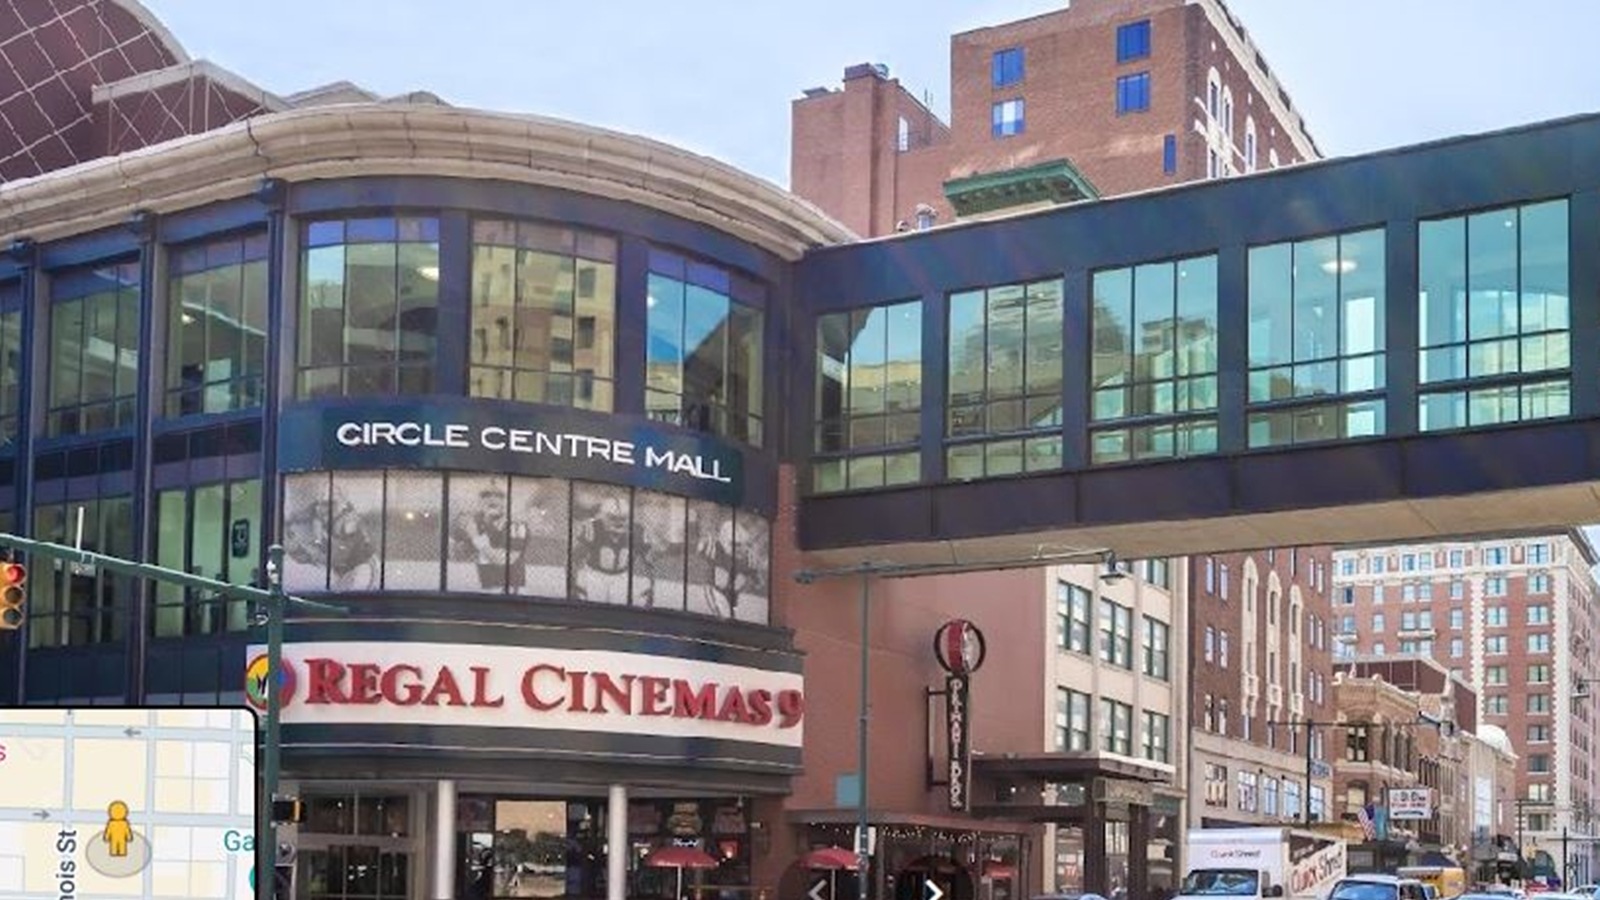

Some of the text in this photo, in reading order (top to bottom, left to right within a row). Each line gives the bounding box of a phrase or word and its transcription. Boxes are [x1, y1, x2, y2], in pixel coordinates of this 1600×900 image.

[336, 422, 732, 483] CIRCLE CENTRE MALL
[304, 656, 805, 729] REGAL CINEMAS 9
